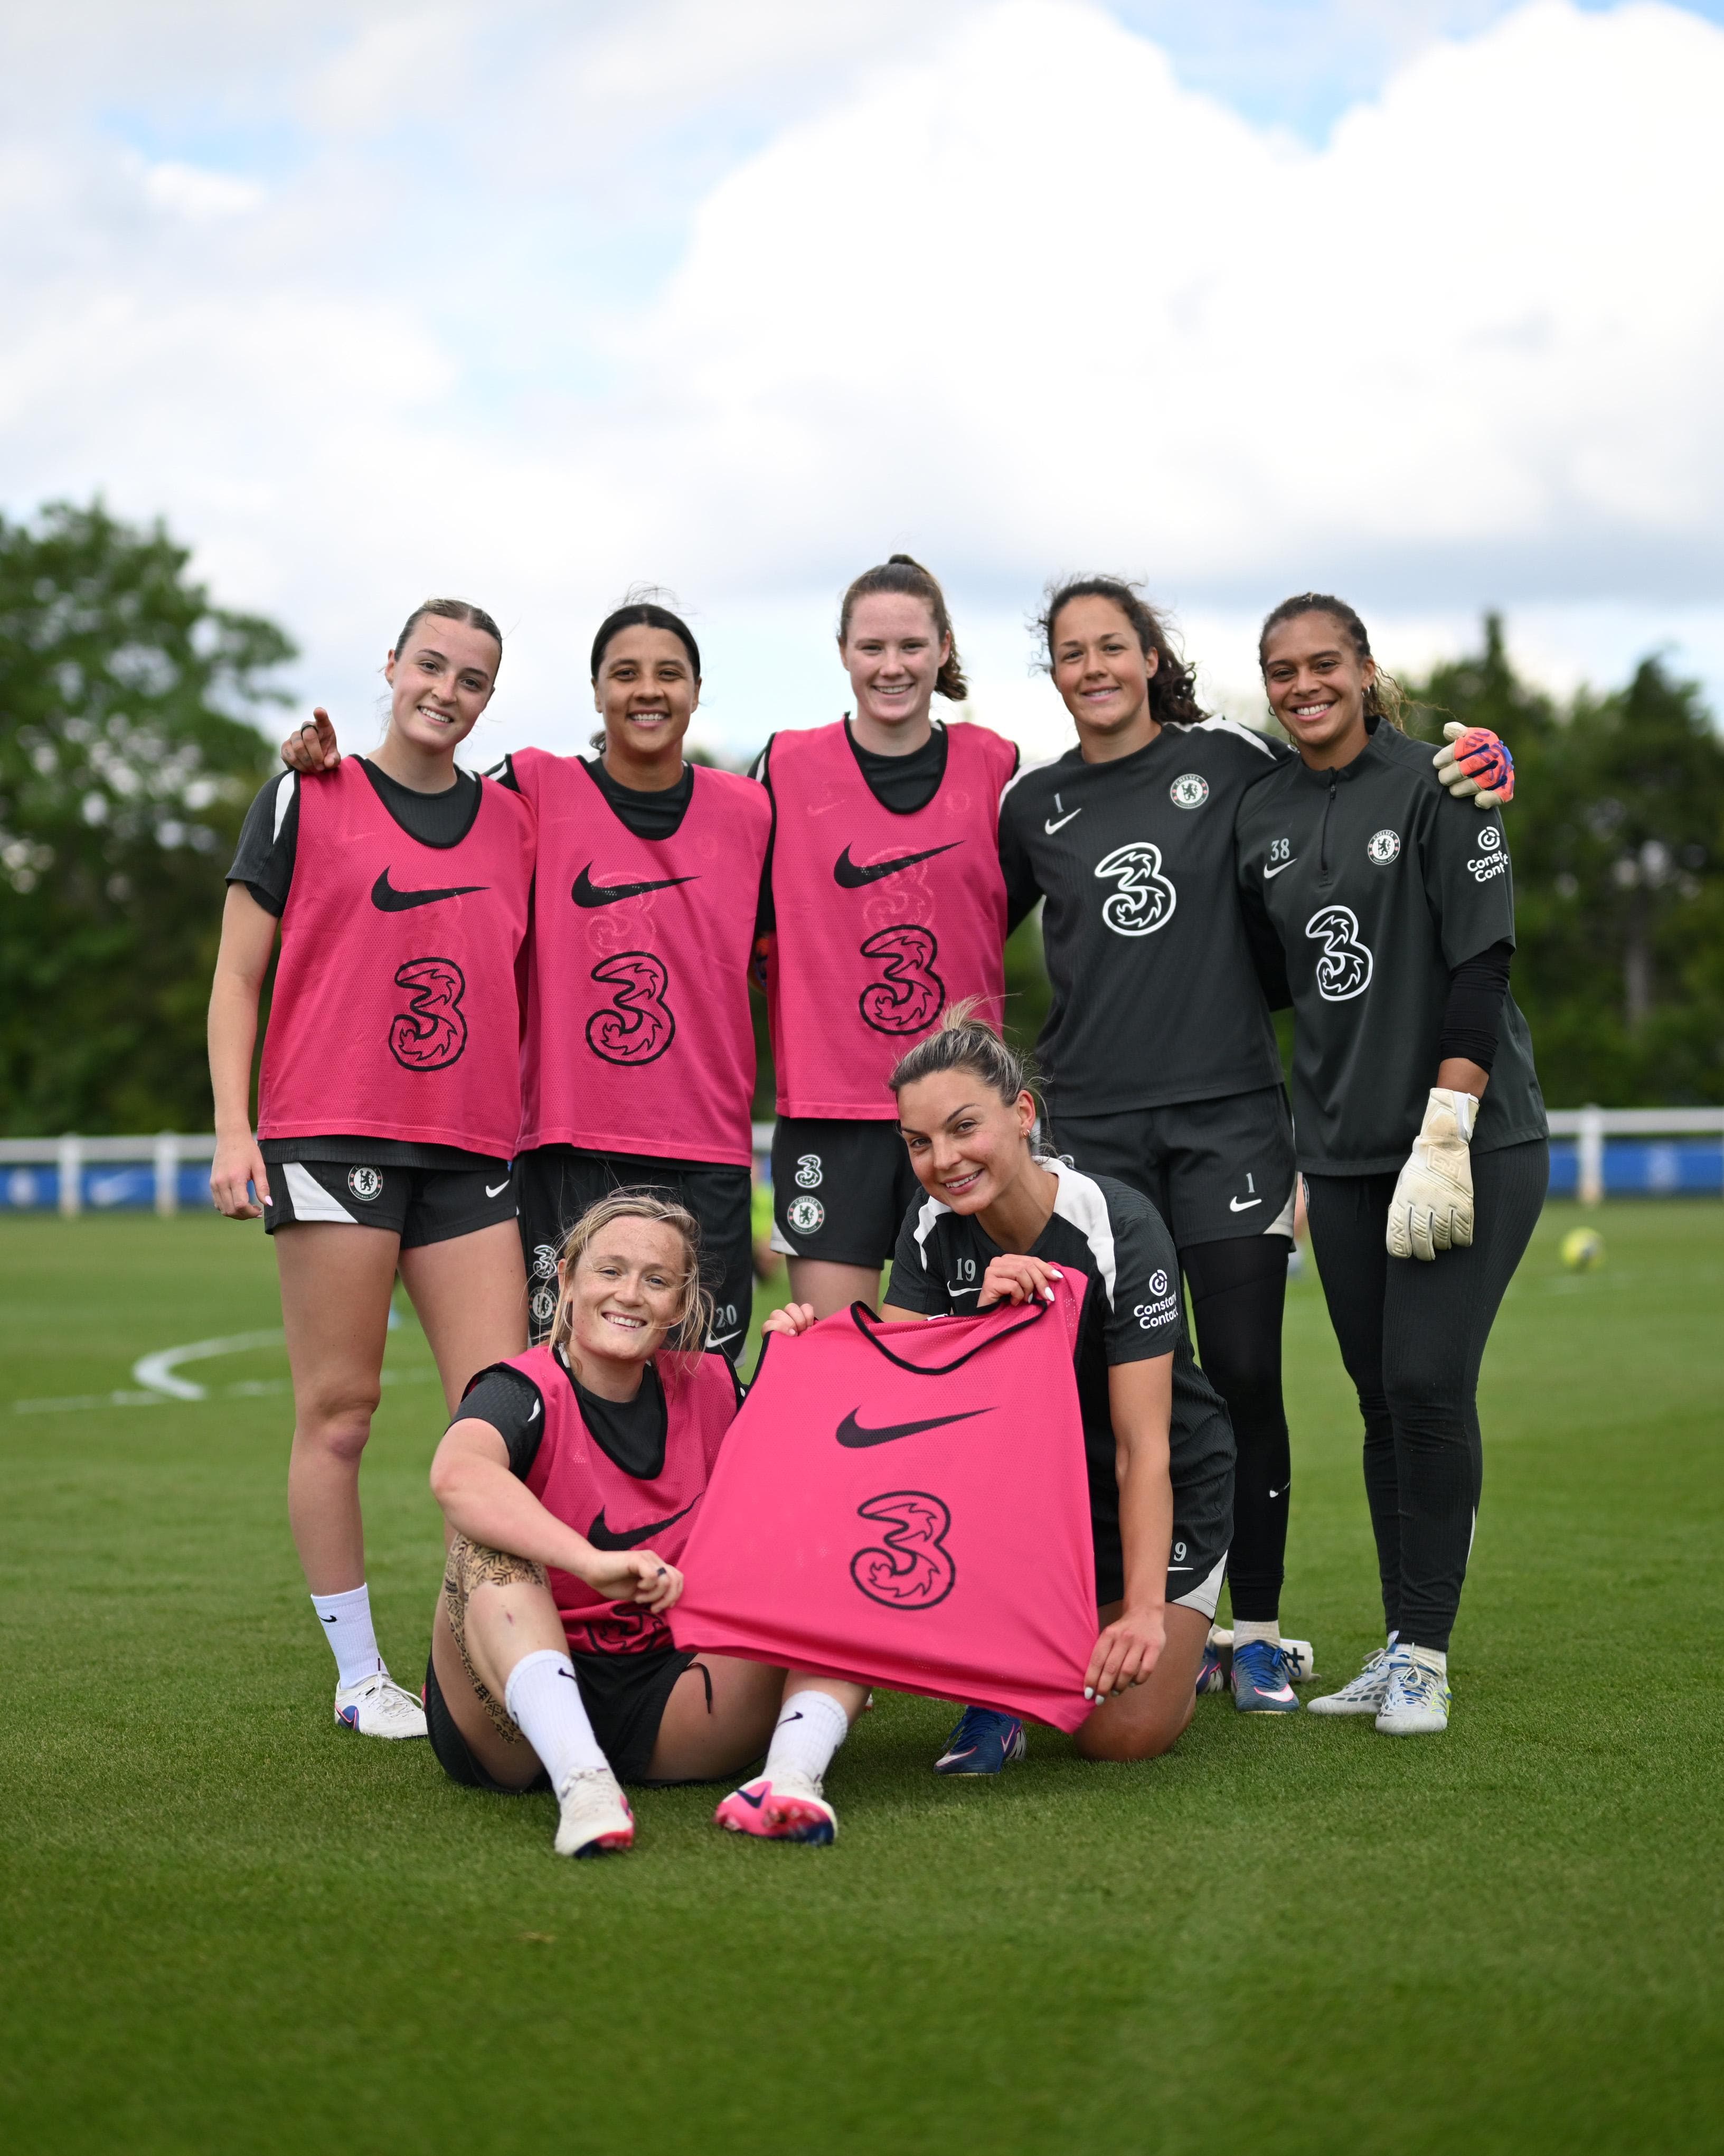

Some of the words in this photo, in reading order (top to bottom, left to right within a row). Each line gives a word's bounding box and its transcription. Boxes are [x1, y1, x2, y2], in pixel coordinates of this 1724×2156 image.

[1054, 793, 1064, 813] 1
[1270, 838, 1290, 861] 38
[1467, 850, 1509, 872] Constt
[1094, 841, 1176, 936] 3
[1475, 862, 1505, 882] Cont
[1305, 905, 1373, 1001] 3
[859, 924, 946, 1036] 3
[388, 957, 468, 1072] 3
[585, 951, 676, 1066] 3
[795, 1154, 823, 1188] 3
[1245, 1172, 1255, 1193] 1
[533, 1244, 557, 1279] 3
[956, 1258, 976, 1282] 19
[715, 1305, 737, 1328] 20
[850, 1491, 956, 1610] 3
